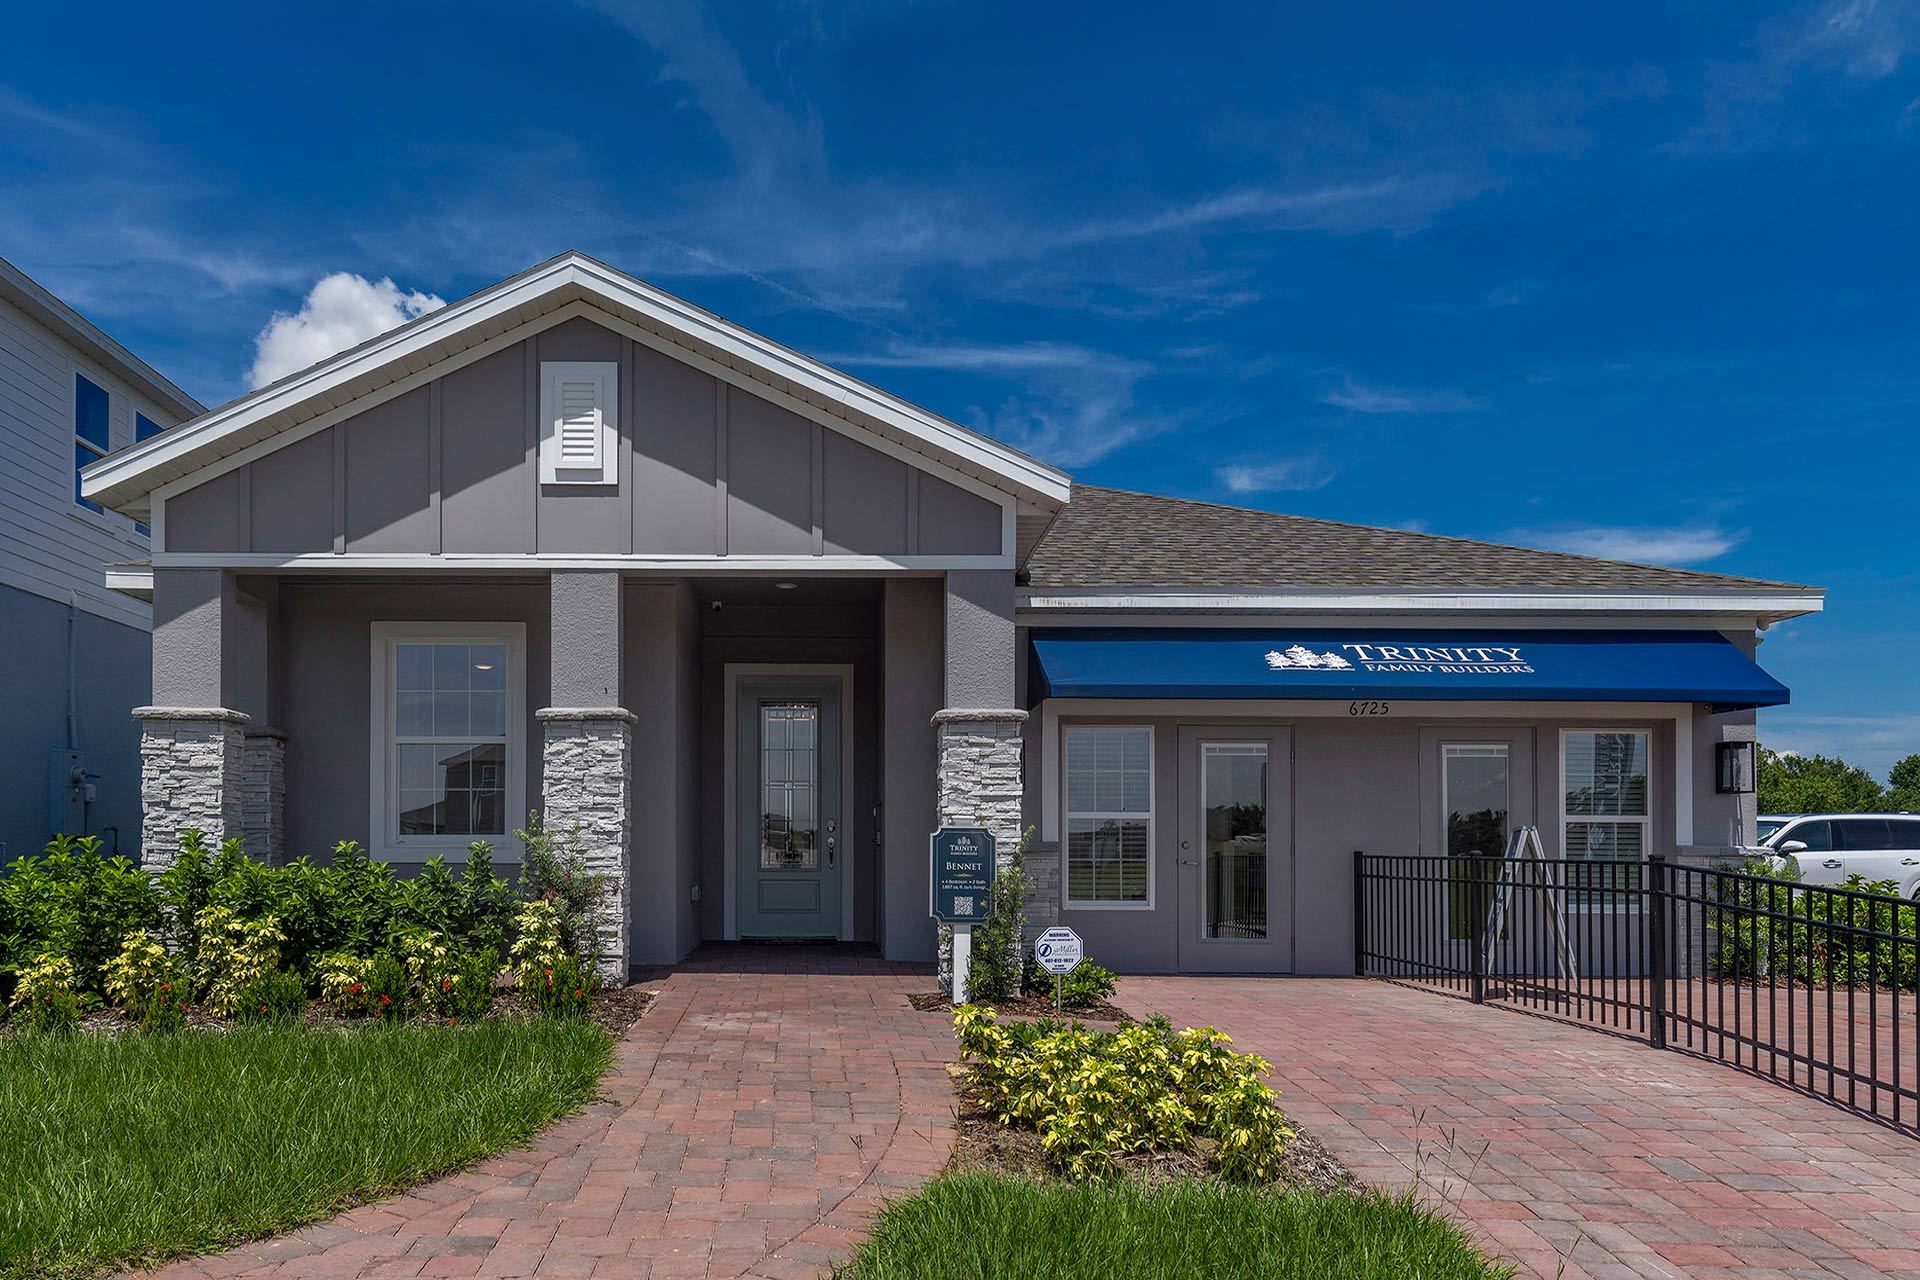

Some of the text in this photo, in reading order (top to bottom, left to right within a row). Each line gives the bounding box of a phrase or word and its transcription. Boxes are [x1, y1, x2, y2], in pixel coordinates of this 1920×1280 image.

[1342, 644, 1524, 662] TRINITY
[1366, 663, 1535, 674] FAMILY BUILDERS
[1349, 701, 1389, 716] 6725
[946, 861, 983, 871] BENNET
